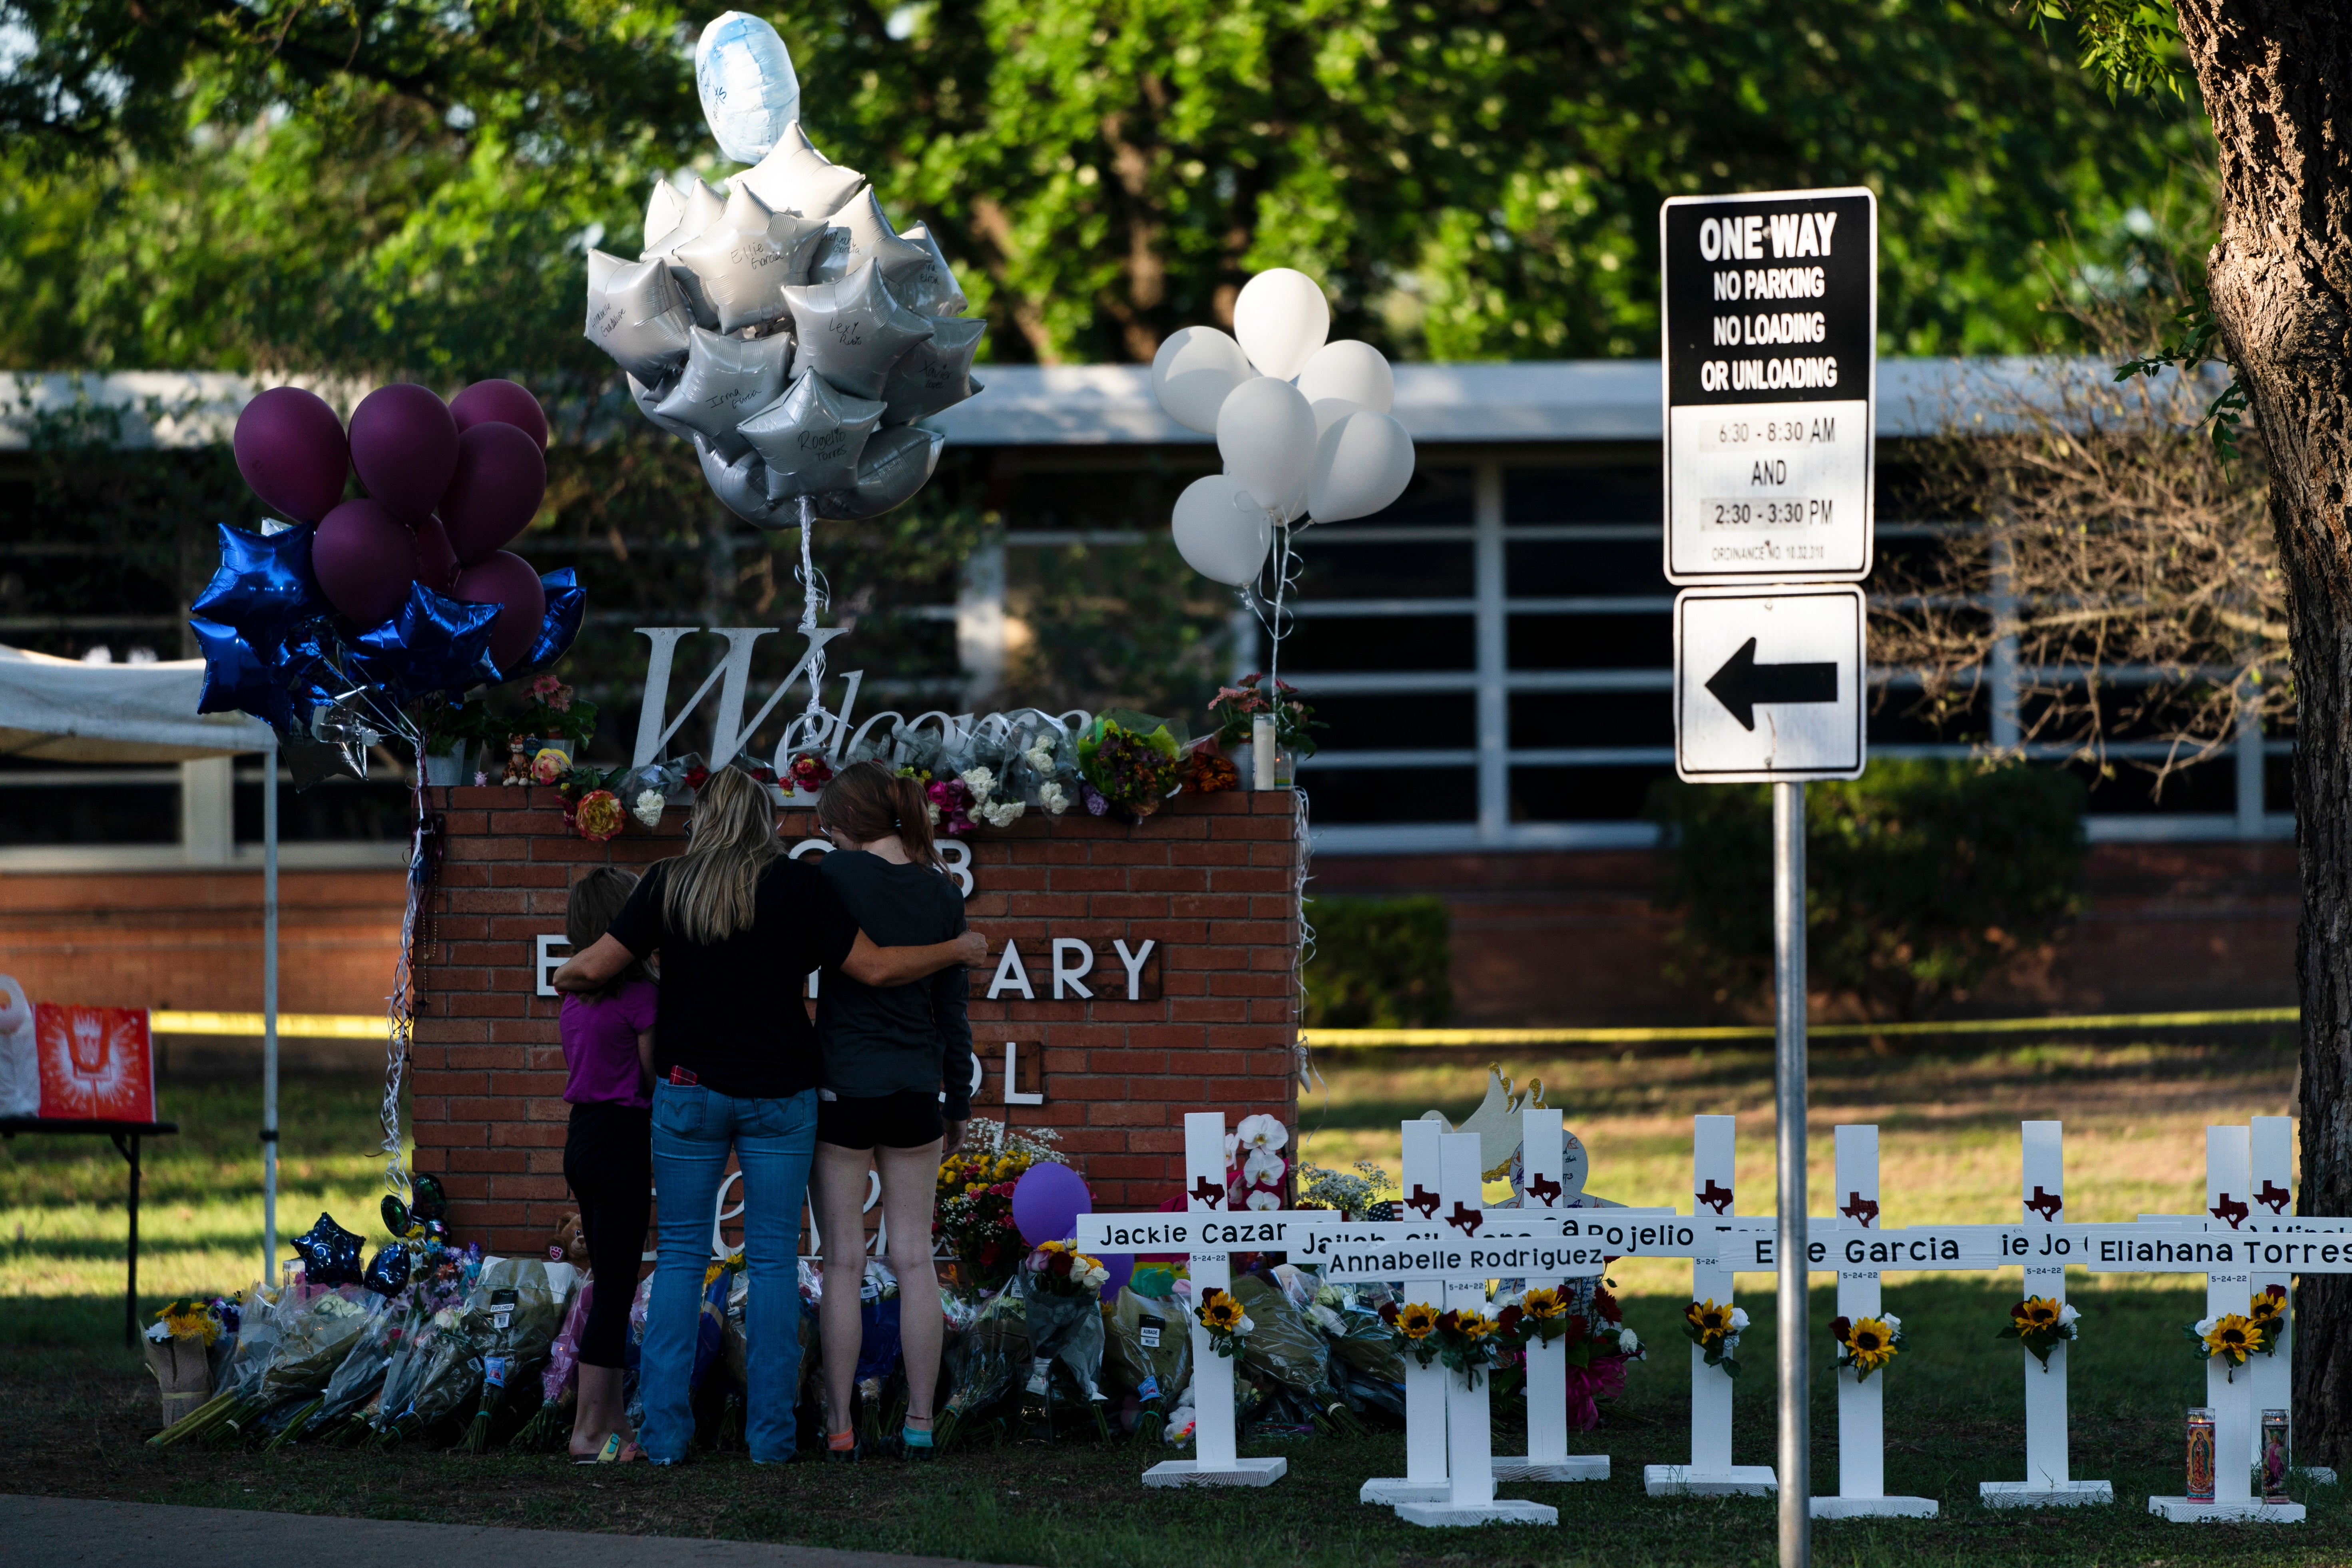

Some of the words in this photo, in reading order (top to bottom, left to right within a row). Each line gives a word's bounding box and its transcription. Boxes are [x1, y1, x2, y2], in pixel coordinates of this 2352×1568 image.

[1699, 215, 1763, 262] ONE
[1770, 211, 1838, 258] WAY
[731, 243, 764, 264] Ellie
[833, 243, 861, 255] Garcia
[751, 254, 784, 270] Garcia
[1714, 270, 1741, 301] NO
[1745, 266, 1825, 300] PARKING
[1713, 315, 1741, 346] NO
[1745, 311, 1825, 345] LOADING
[919, 359, 954, 380] Xavier
[1701, 360, 1730, 392] OR
[1732, 356, 1838, 391] UNLOADING
[705, 389, 741, 408] Irma
[798, 427, 846, 451] Rogelio
[1719, 422, 1749, 442] 6:30
[1767, 421, 1803, 442] 8:30
[1810, 417, 1835, 443] AM
[816, 444, 847, 462] Torres
[1751, 460, 1787, 486] AND
[1715, 504, 1751, 524] 2:30
[1767, 503, 1803, 523] 3:30
[1810, 500, 1833, 525] PM
[1100, 1224, 1187, 1246] Jackie
[1202, 1223, 1288, 1244] Cazar
[2039, 1233, 2071, 1255] Jo
[1329, 1251, 1462, 1273] Annabelle
[1471, 1247, 1603, 1271] Rodriguez
[1845, 1237, 1960, 1263] Garcia
[2100, 1240, 2233, 1263] Eliahana
